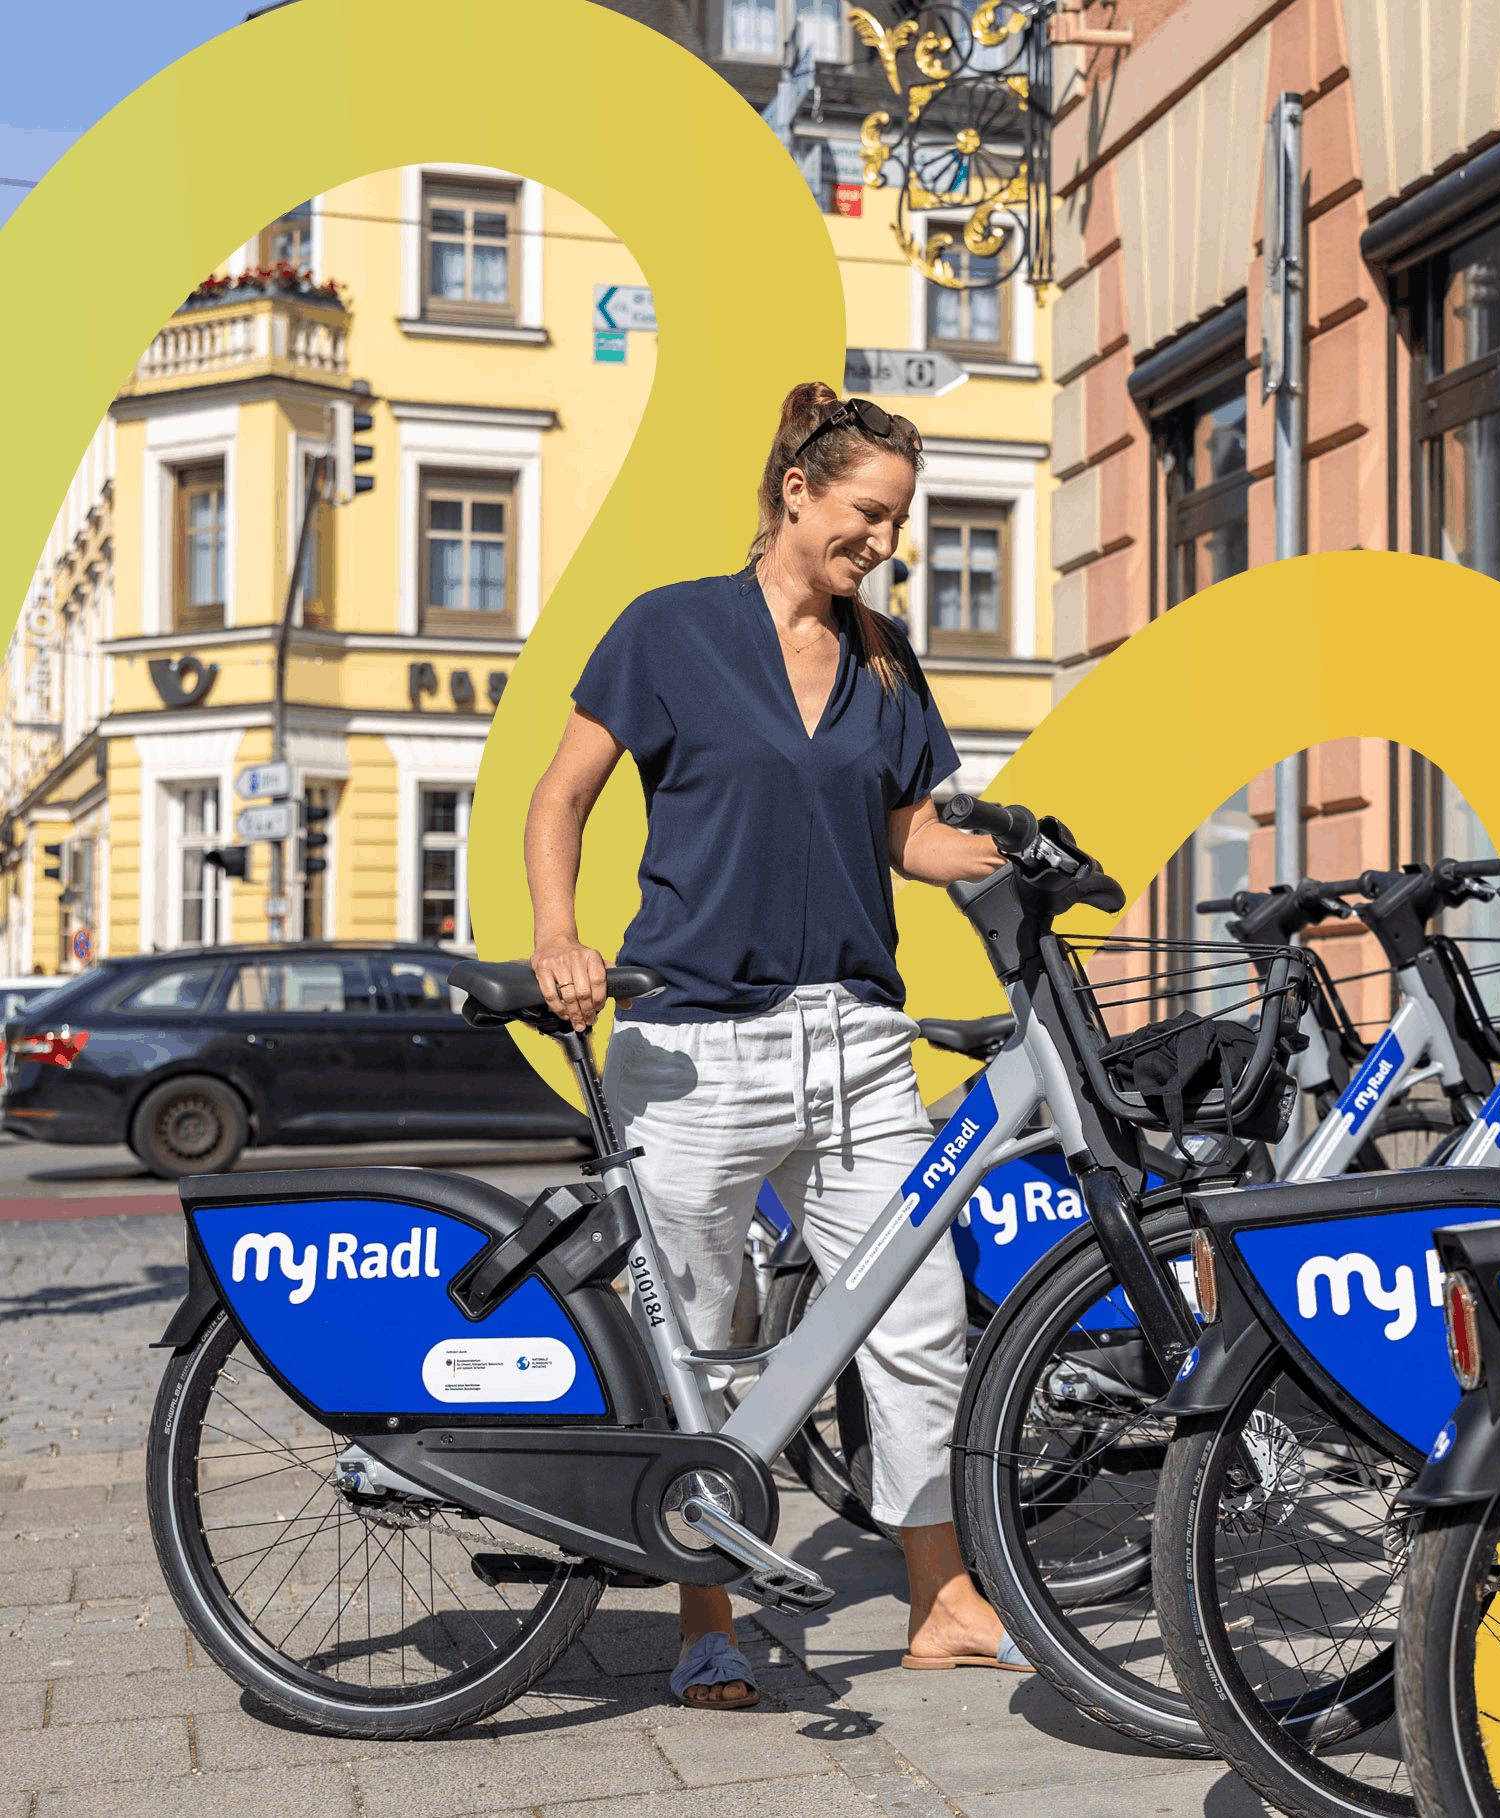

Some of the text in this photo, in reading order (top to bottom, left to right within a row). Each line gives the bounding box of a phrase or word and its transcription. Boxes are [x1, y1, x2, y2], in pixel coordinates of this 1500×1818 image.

[630, 1256, 665, 1329] 910184
[164, 1382, 183, 1436] SCHWALBE
[1192, 1467, 1205, 1497] PLUS
[1186, 1499, 1197, 1545] CRUISER
[1197, 1639, 1227, 1701] SCHWALBE
